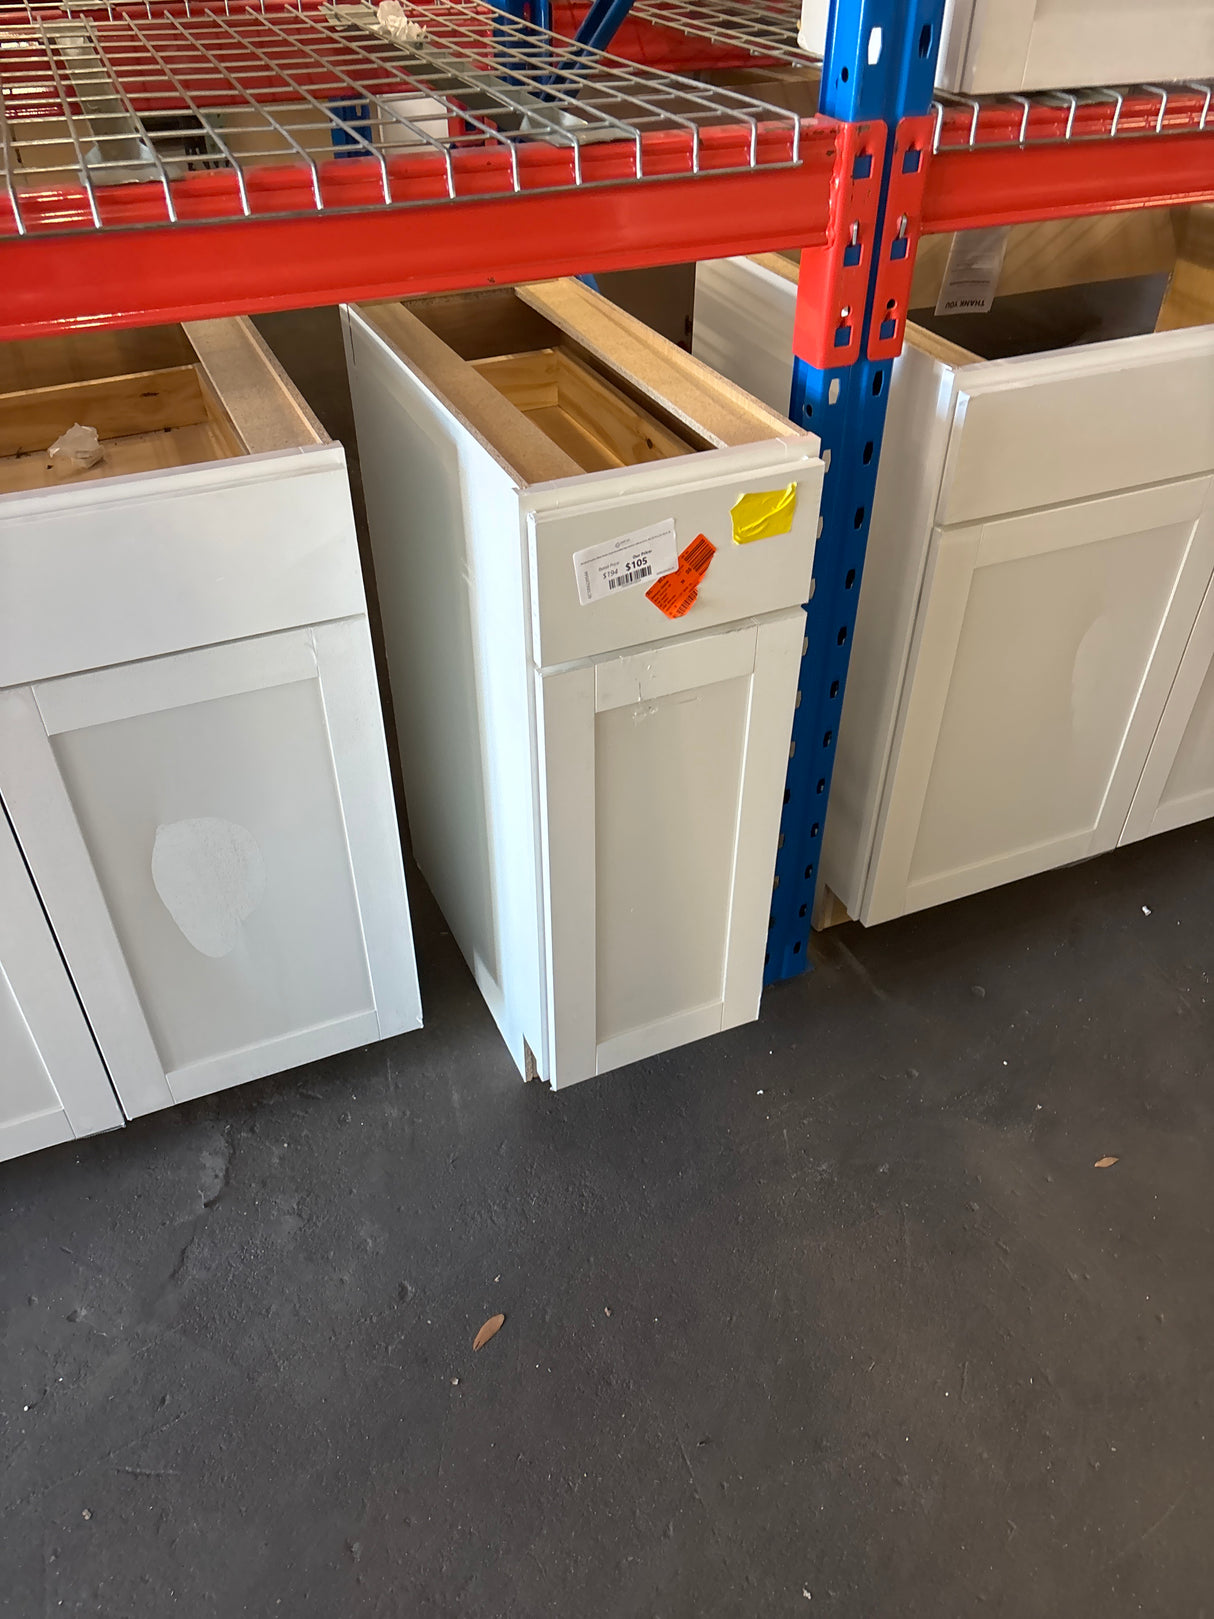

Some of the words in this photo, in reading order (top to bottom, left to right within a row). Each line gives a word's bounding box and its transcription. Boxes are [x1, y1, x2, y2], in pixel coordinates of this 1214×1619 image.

[945, 300, 958, 309] YOU
[959, 299, 985, 308] THANK
[625, 556, 648, 572] $105
[602, 568, 618, 580] $194
